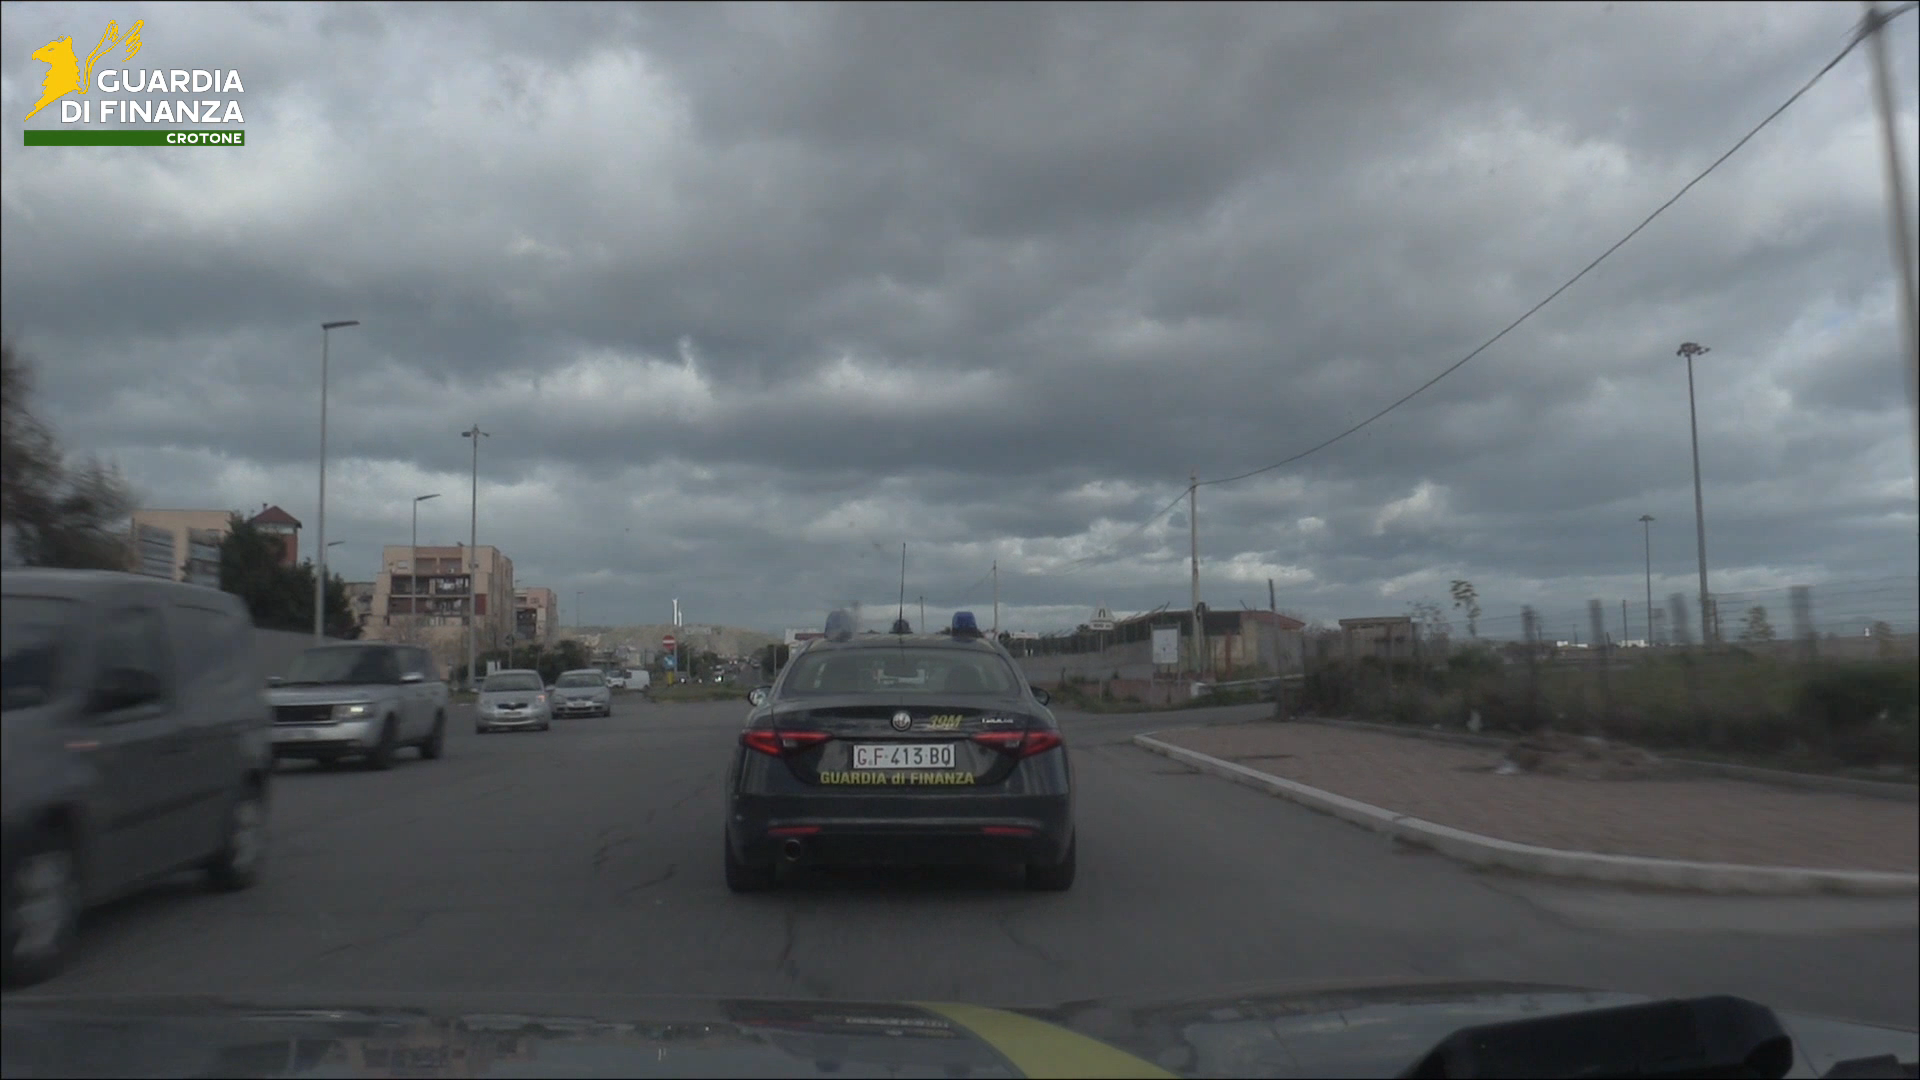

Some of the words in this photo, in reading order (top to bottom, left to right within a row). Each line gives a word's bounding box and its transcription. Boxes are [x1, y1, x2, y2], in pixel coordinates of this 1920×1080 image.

[891, 747, 923, 765] 413
[820, 771, 886, 785] GUARDIA
[891, 771, 906, 785] di
[910, 771, 975, 785] FINANZA
